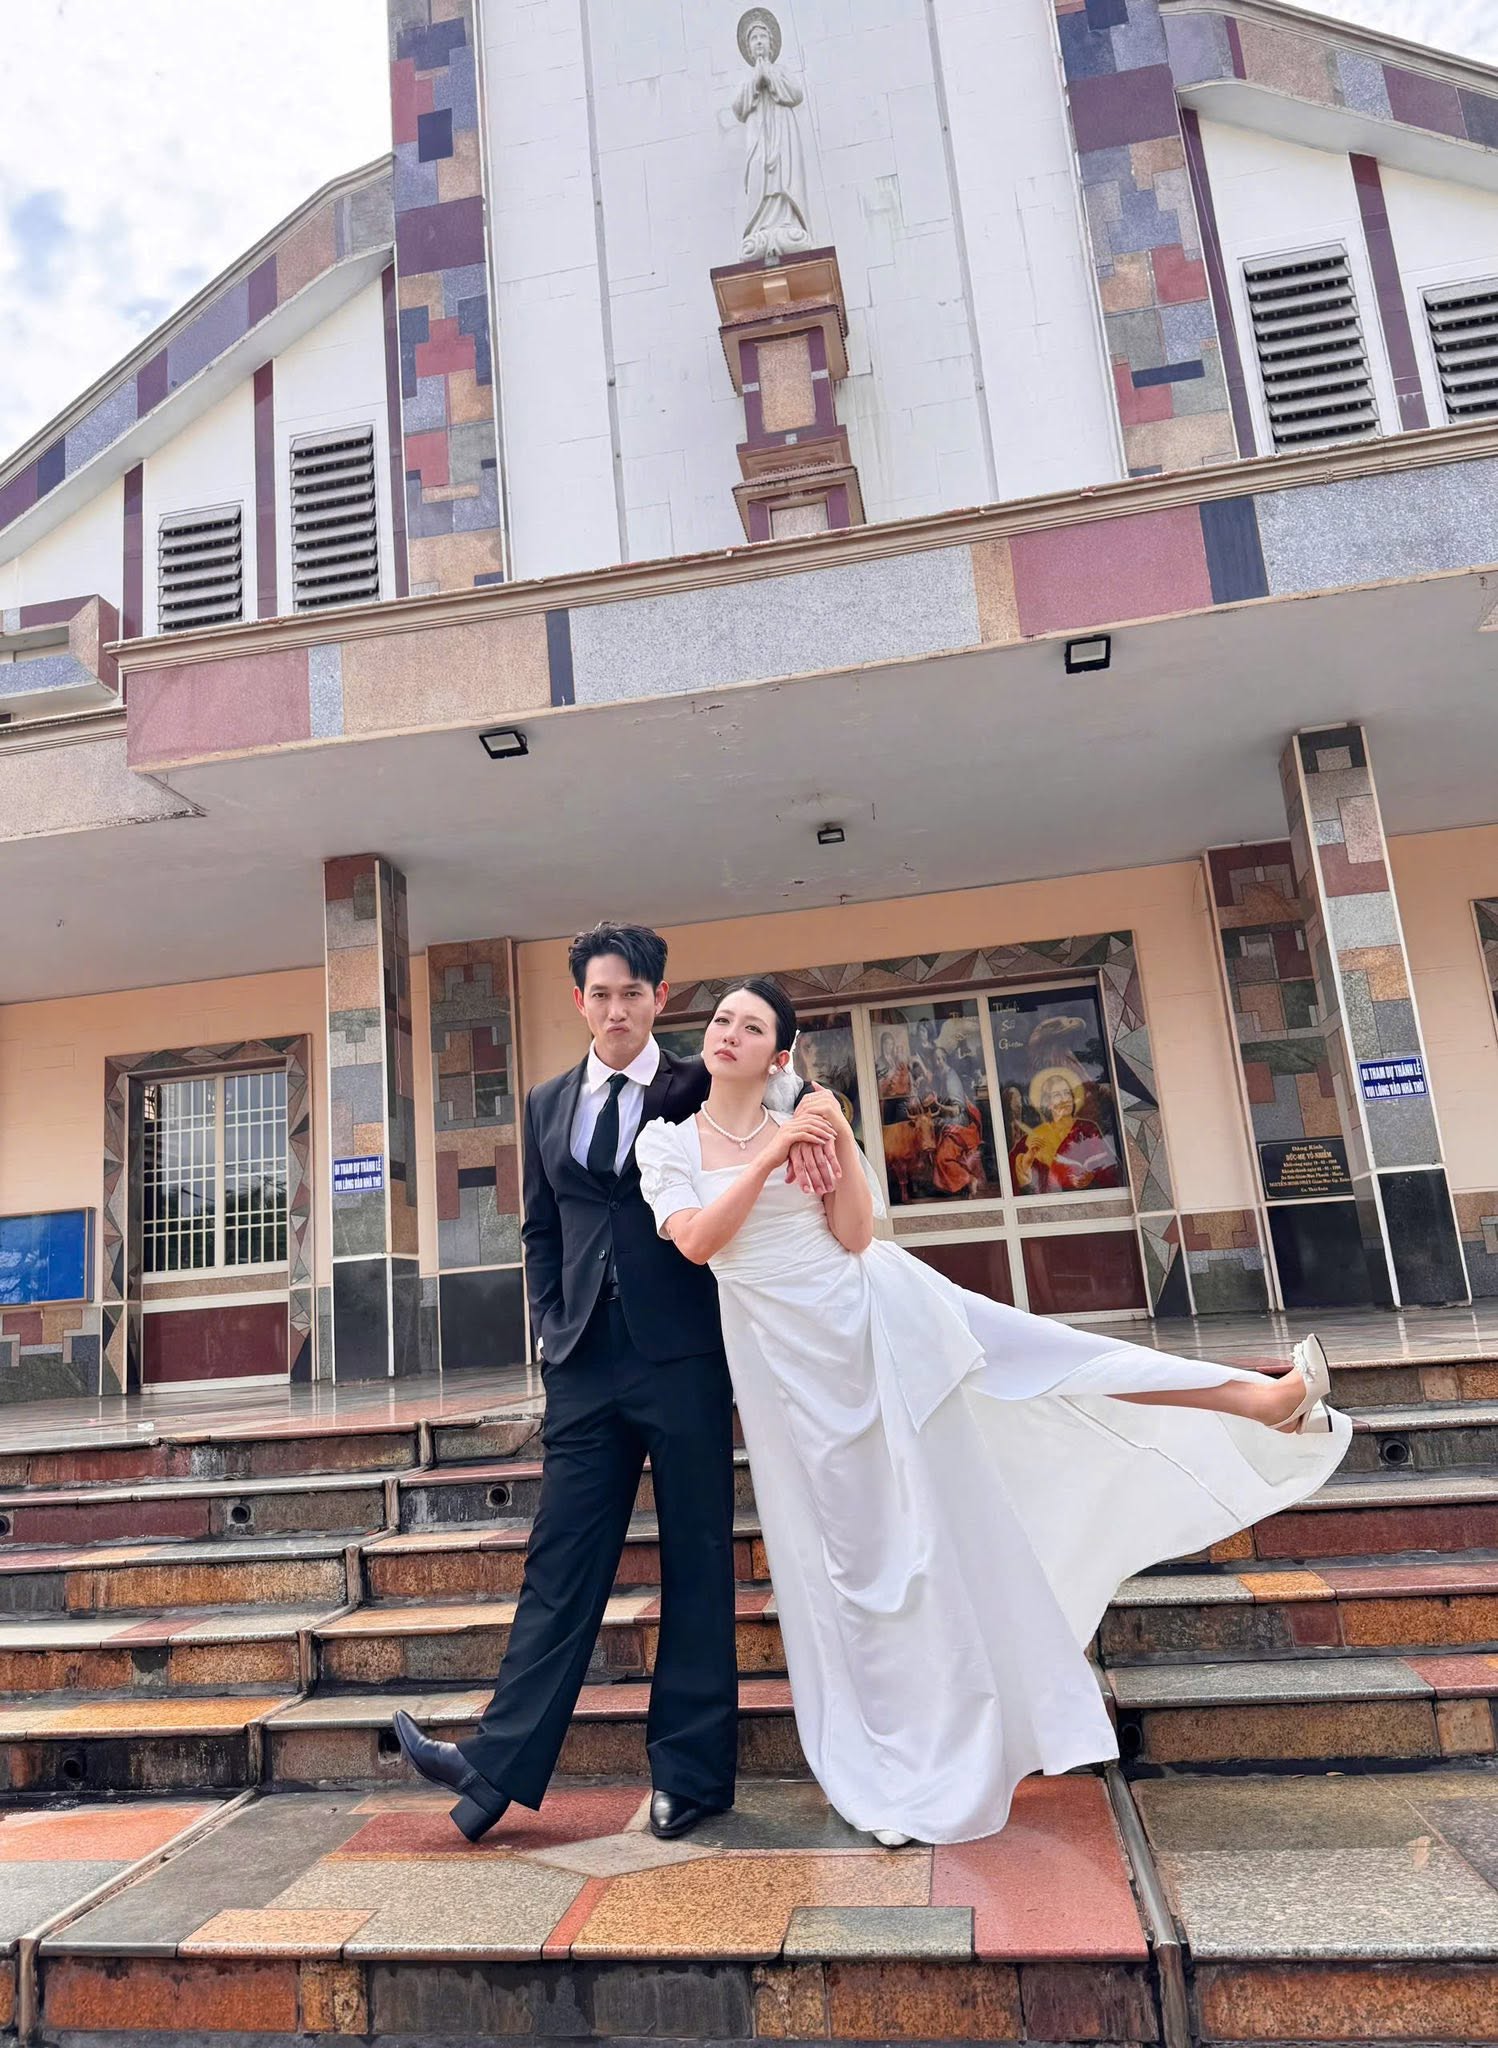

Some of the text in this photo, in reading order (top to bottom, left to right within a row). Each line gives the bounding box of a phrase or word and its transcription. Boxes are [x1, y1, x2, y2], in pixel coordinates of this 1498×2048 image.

[1368, 1066, 1387, 1080] THAM
[1394, 1062, 1415, 1077] THÁNH
[1365, 1085, 1376, 1098] VUI
[1374, 1082, 1391, 1097] LÒNG
[1389, 1081, 1402, 1095] VÀO
[1400, 1080, 1414, 1094] NHÀ
[340, 1162, 353, 1175] THAM
[360, 1159, 376, 1173] THÁNH
